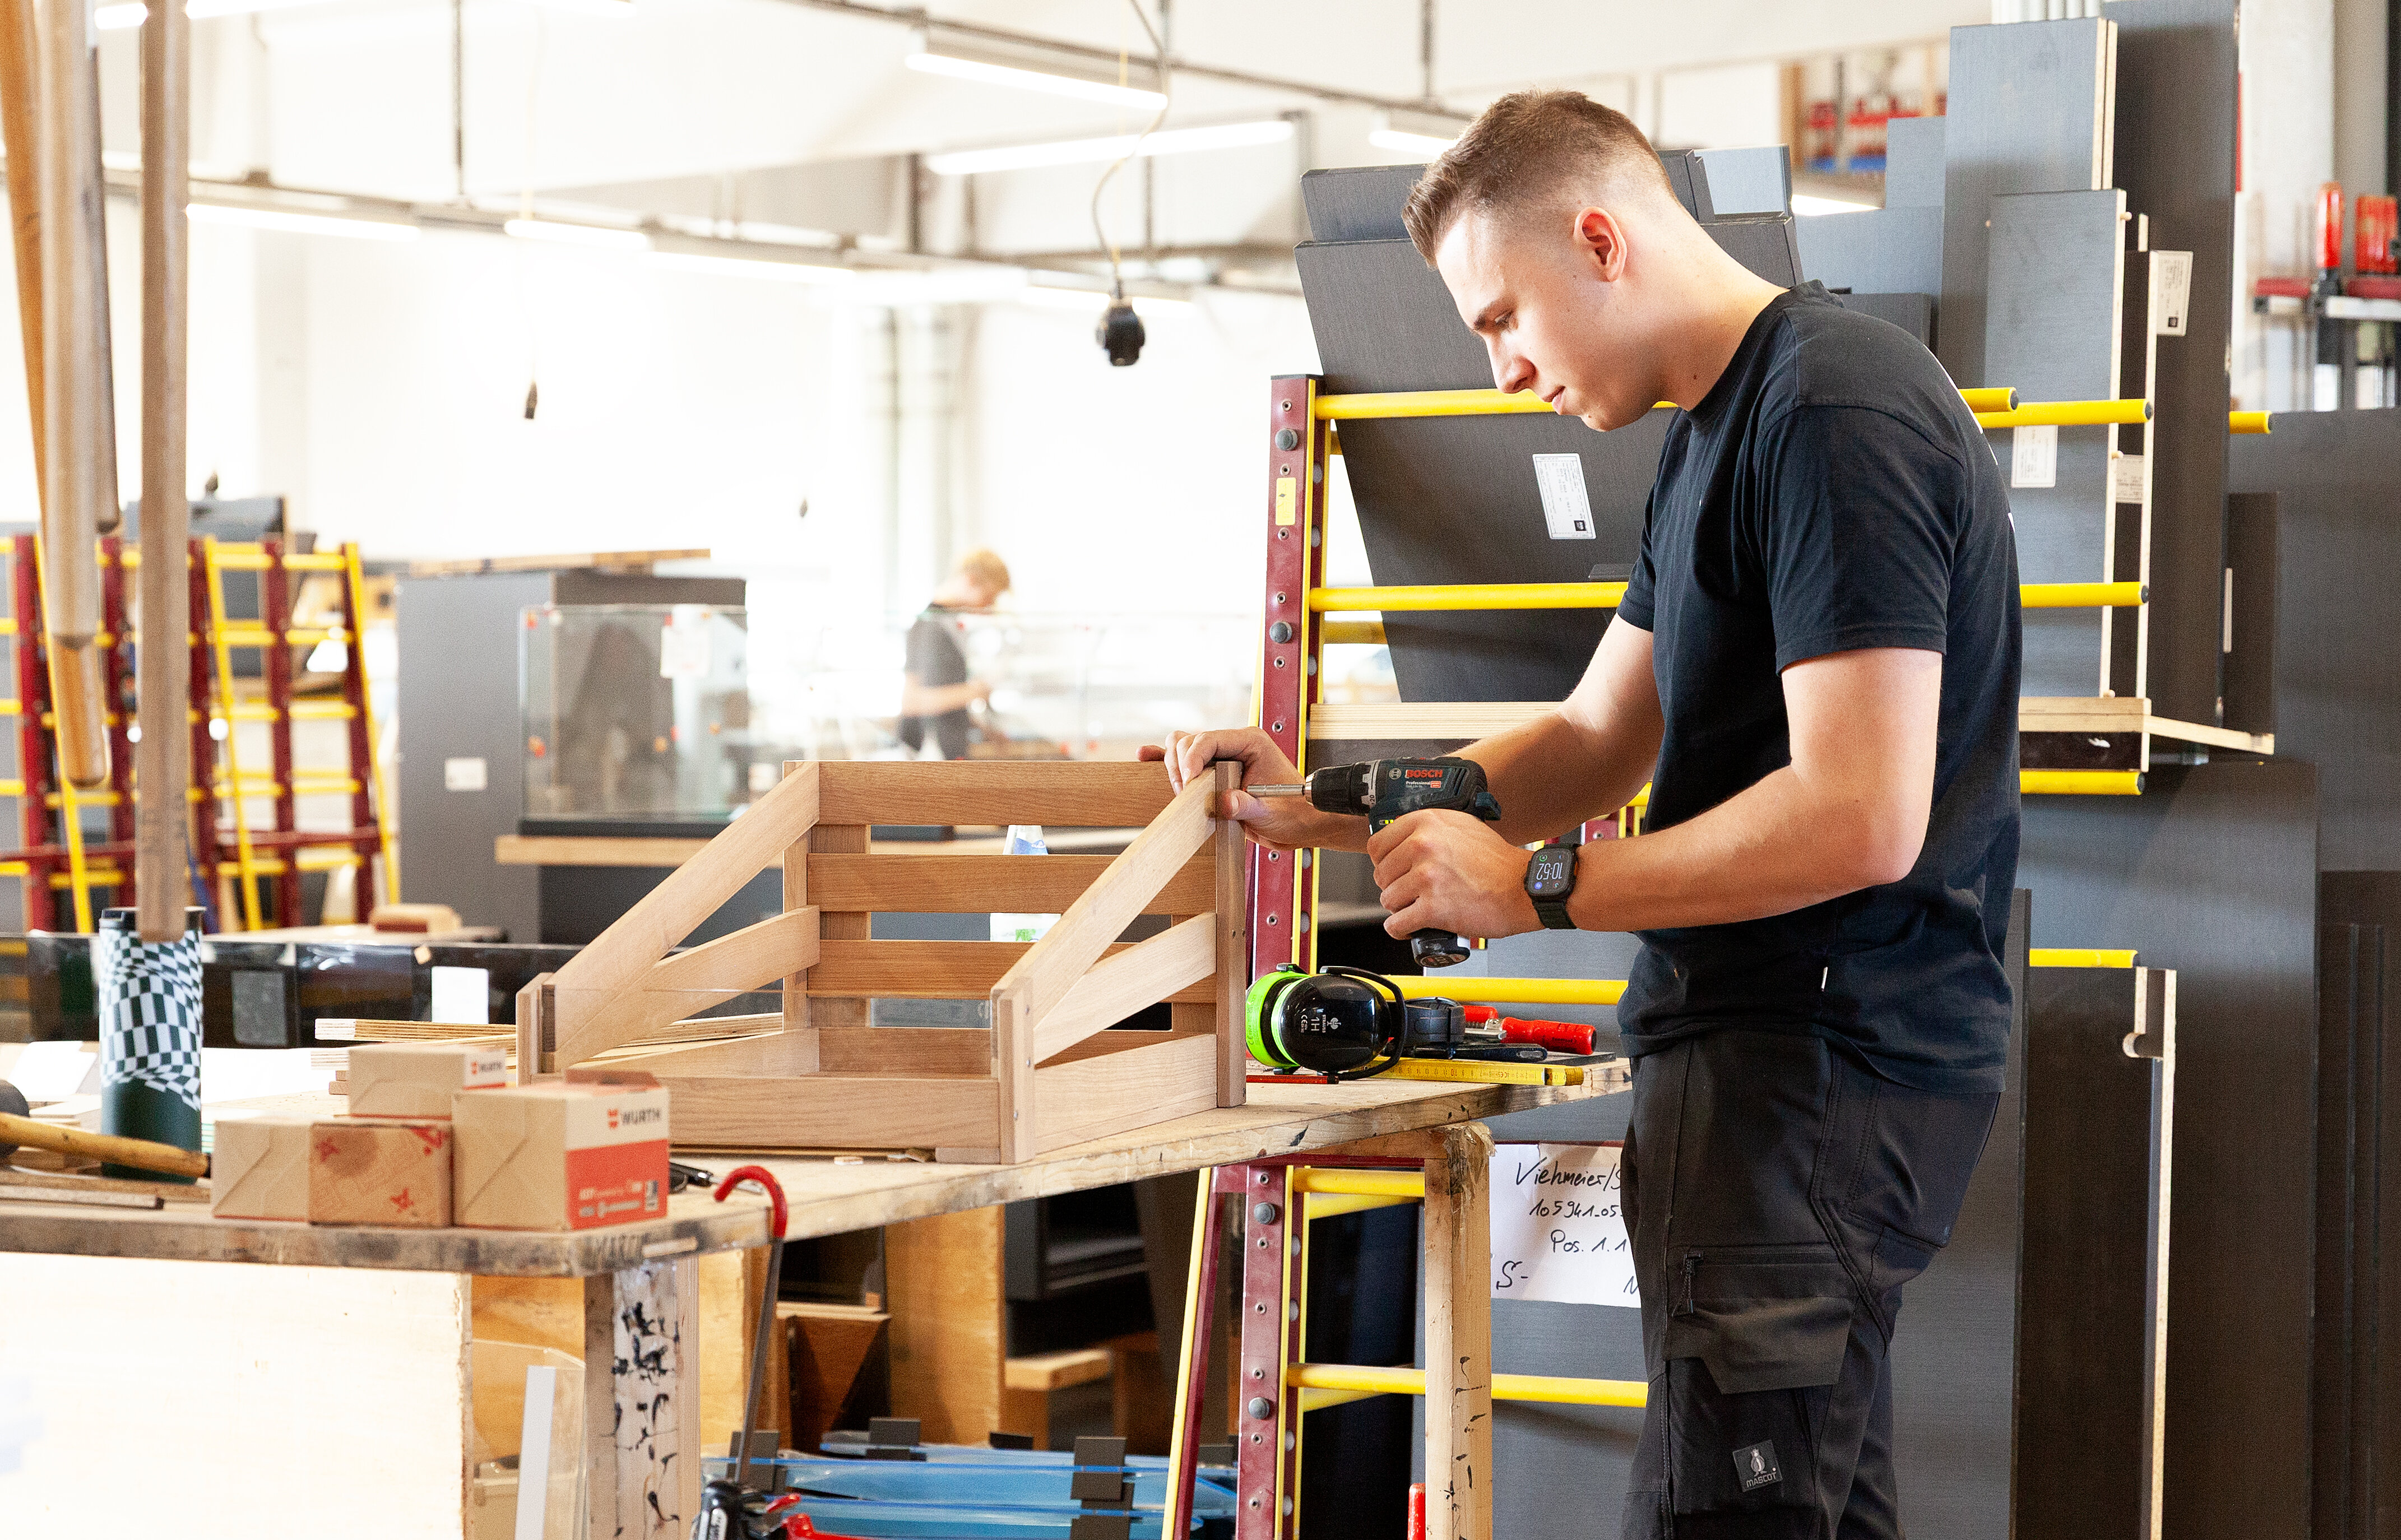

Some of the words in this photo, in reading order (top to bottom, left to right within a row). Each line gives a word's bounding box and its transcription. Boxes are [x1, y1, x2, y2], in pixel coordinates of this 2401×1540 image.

[1405, 769, 1443, 778] BOSCH
[1536, 862, 1563, 880] 10:52
[1311, 1017, 1320, 1031] 1H
[1551, 1229, 1583, 1253] Pos.
[1746, 1472, 1777, 1487] MASCOT
